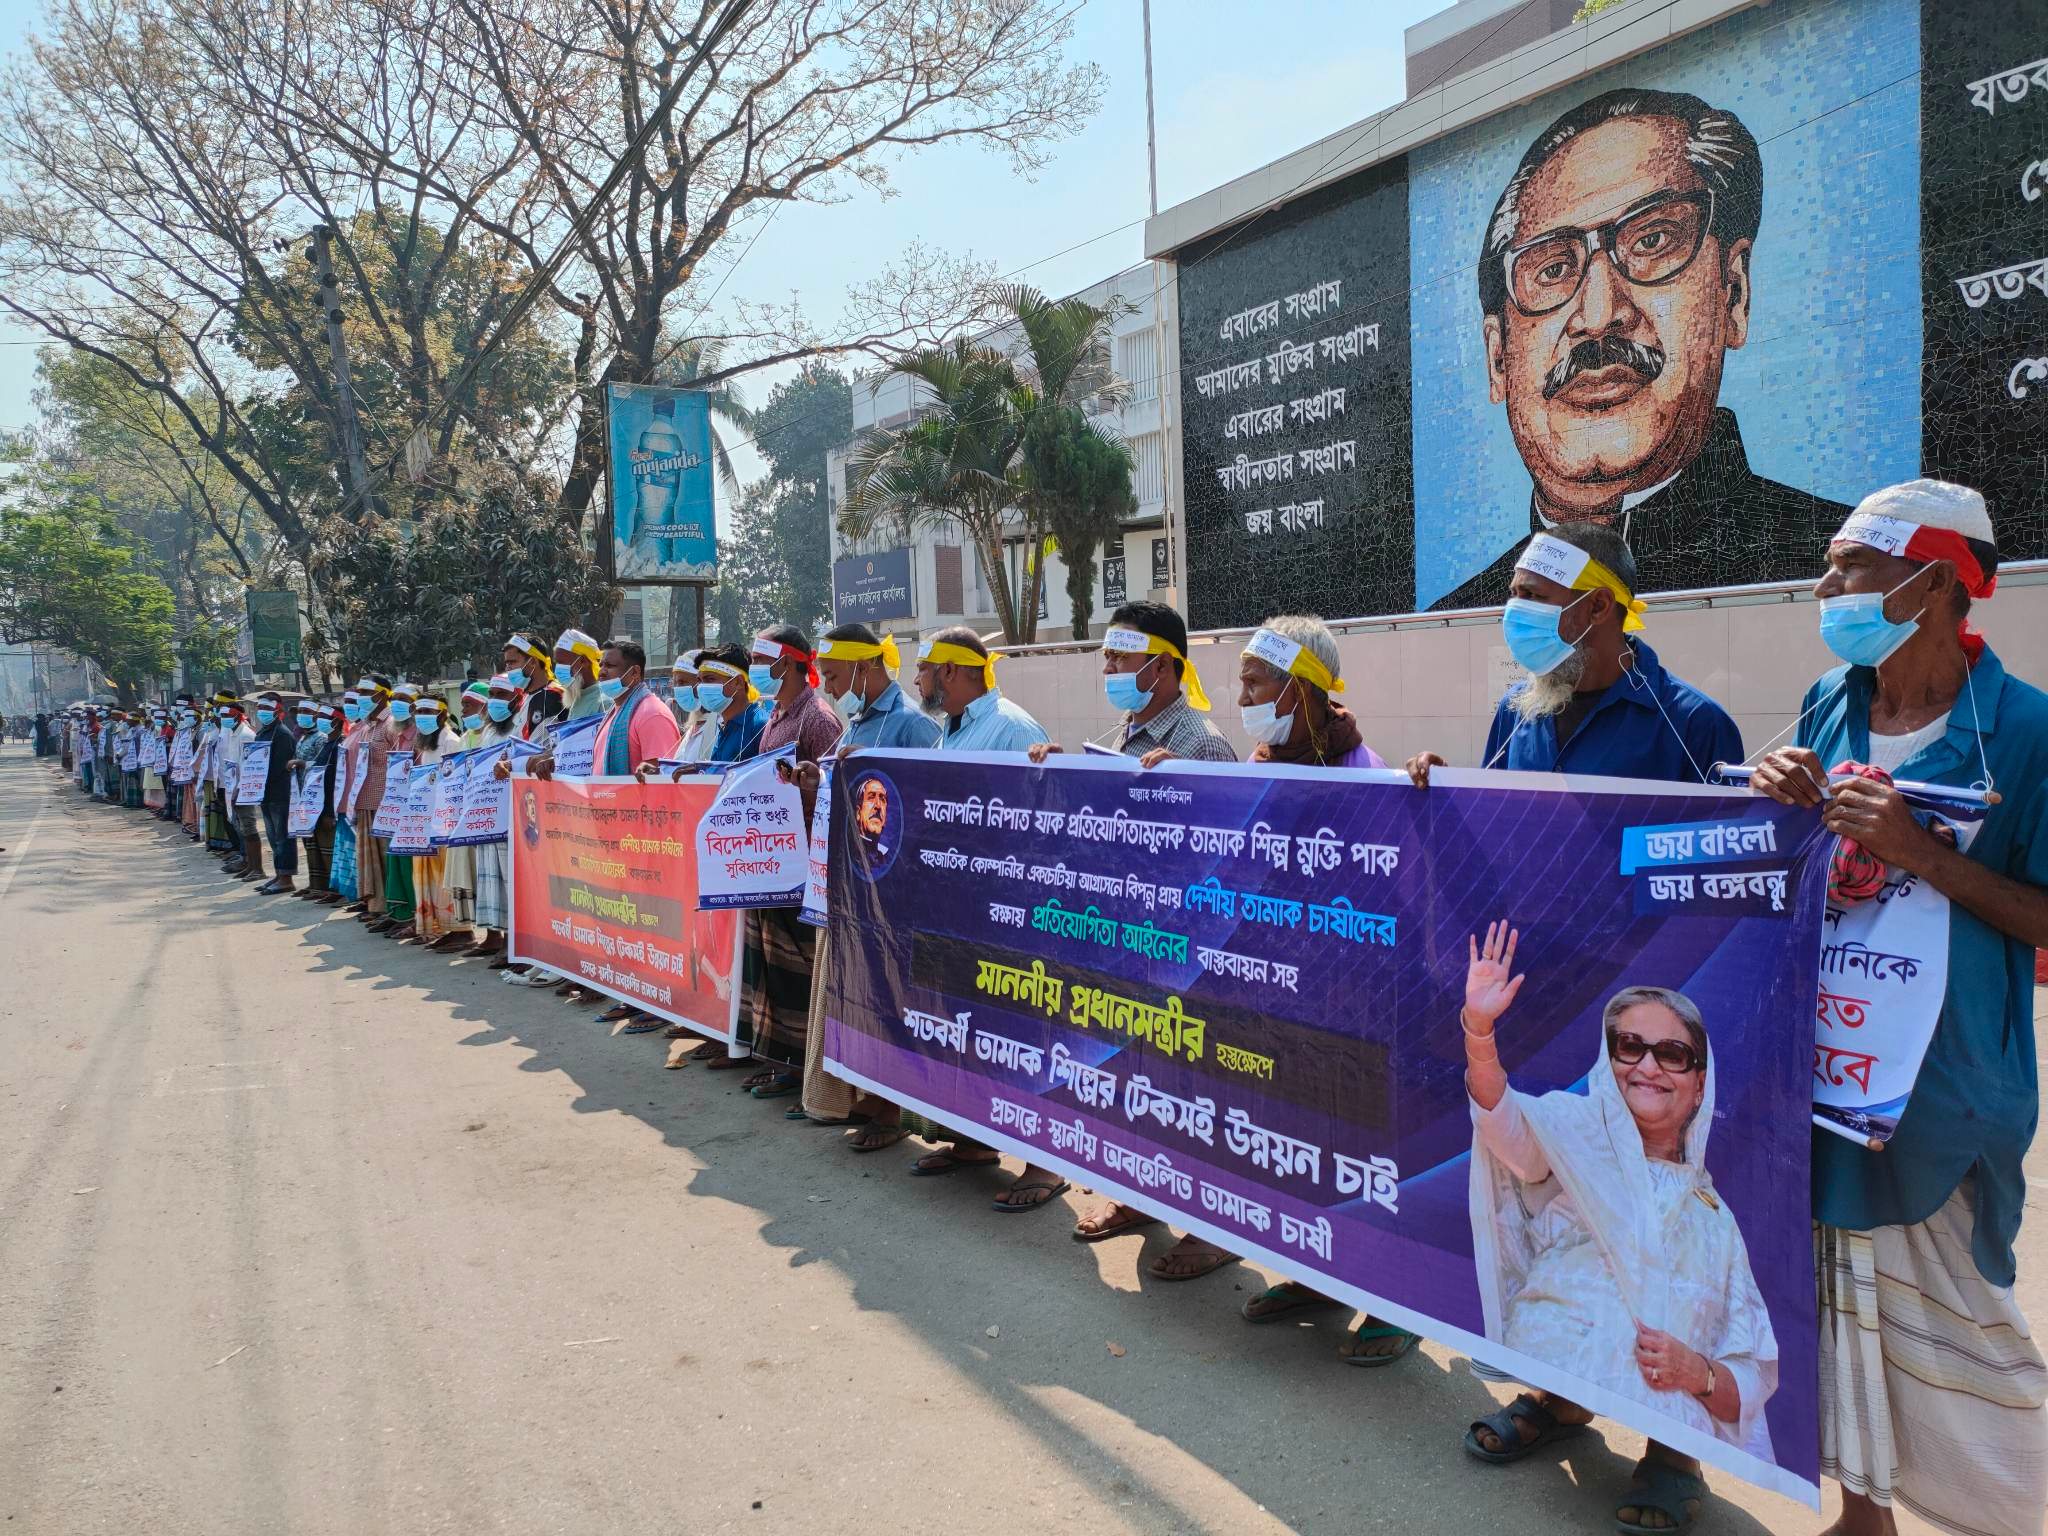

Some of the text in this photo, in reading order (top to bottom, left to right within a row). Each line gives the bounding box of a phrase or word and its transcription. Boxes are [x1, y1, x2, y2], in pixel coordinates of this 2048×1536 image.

[1220, 280, 1341, 342] এবারের সংগ্রাম
[1195, 323, 1380, 399] আমাদের মুক্তির সংগ্রাম
[1224, 388, 1346, 441] এবারের সংগ্রাম
[1216, 440, 1356, 492] স্বাধীনতার সংগ্রাম
[1245, 497, 1325, 536] জয় বাংলা
[709, 808, 790, 827] বাজেট কি শুধুই
[721, 795, 747, 807] তামাক
[705, 828, 798, 856] বিদেশীদের
[923, 796, 1400, 878] মনোপলি নিপাত যাক প্রতিযোগিতামূলক তামাক শিল্প মুক্তি পাক
[1645, 821, 1778, 861] জয় বাংলা
[725, 856, 781, 880] সুবিধার্থে?
[1648, 870, 1789, 912] জয় বঙ্গবন্ধু
[919, 847, 1398, 947] বহুজাতিক কোম্পানীর একচেটিয়া আগ্রাসনে বিপন্ন প্রায় দেশীয় তামাক চাষীদের
[989, 898, 1299, 993] রক্ষায় প্রতিযোগিতা আইনের বাস্তবায়ন সহ
[976, 959, 1275, 1080] মাননীয় প্রধানমন্ত্রীর হস্তক্ষেপে
[902, 1007, 1401, 1216] শতবর্ষী তামাক শিল্পের টেকসই উন্নয়ন চাই
[990, 1096, 1334, 1262] প্রচারে: স্থানীয় অবহেলিত তামাক চাষী
